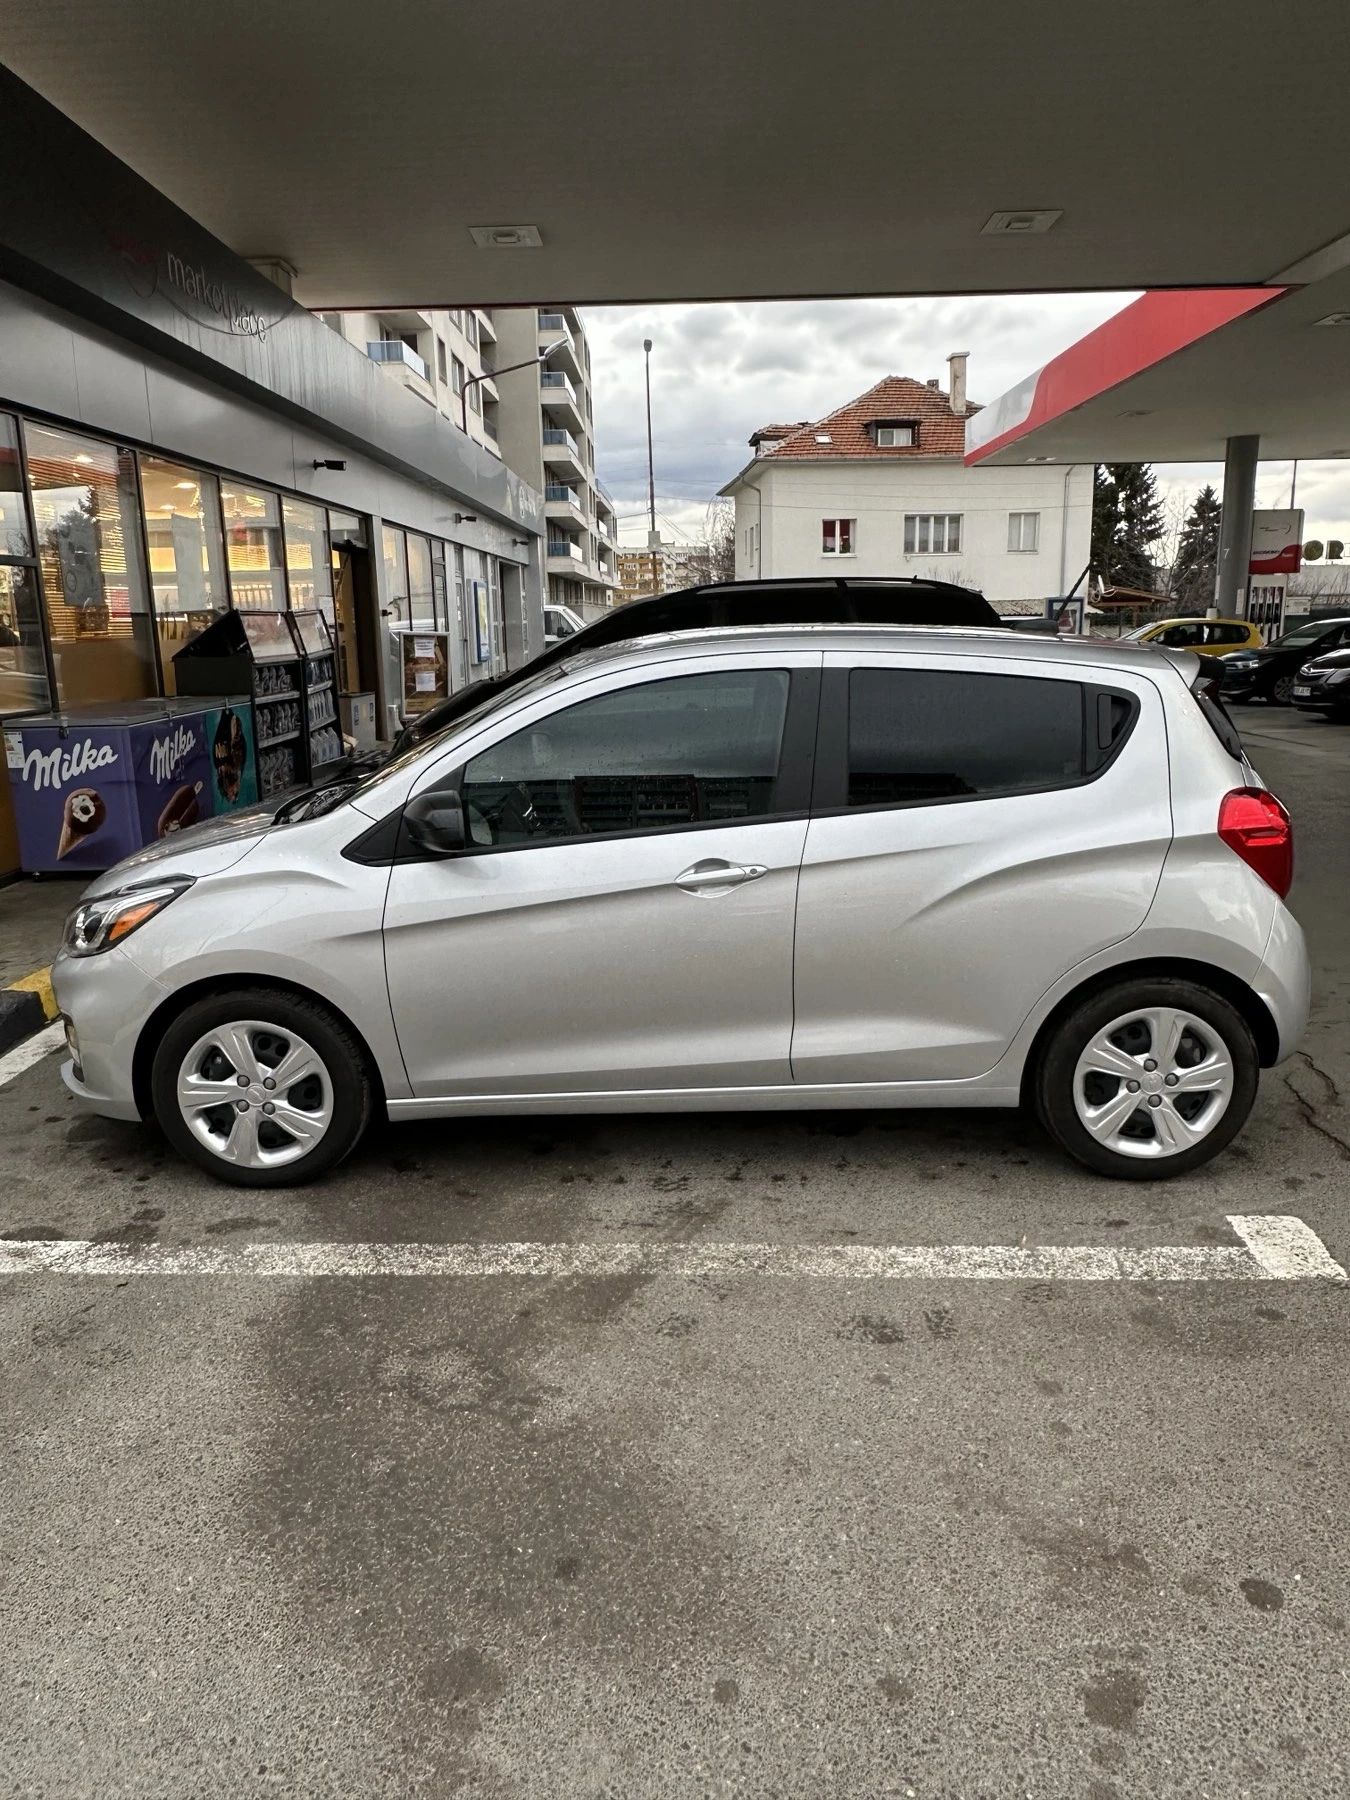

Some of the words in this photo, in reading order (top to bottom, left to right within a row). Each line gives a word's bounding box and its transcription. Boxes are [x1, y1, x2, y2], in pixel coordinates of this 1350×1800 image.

[1223, 548, 1230, 559] 7
[22, 738, 118, 791] Milka
[150, 724, 196, 784] Milka
